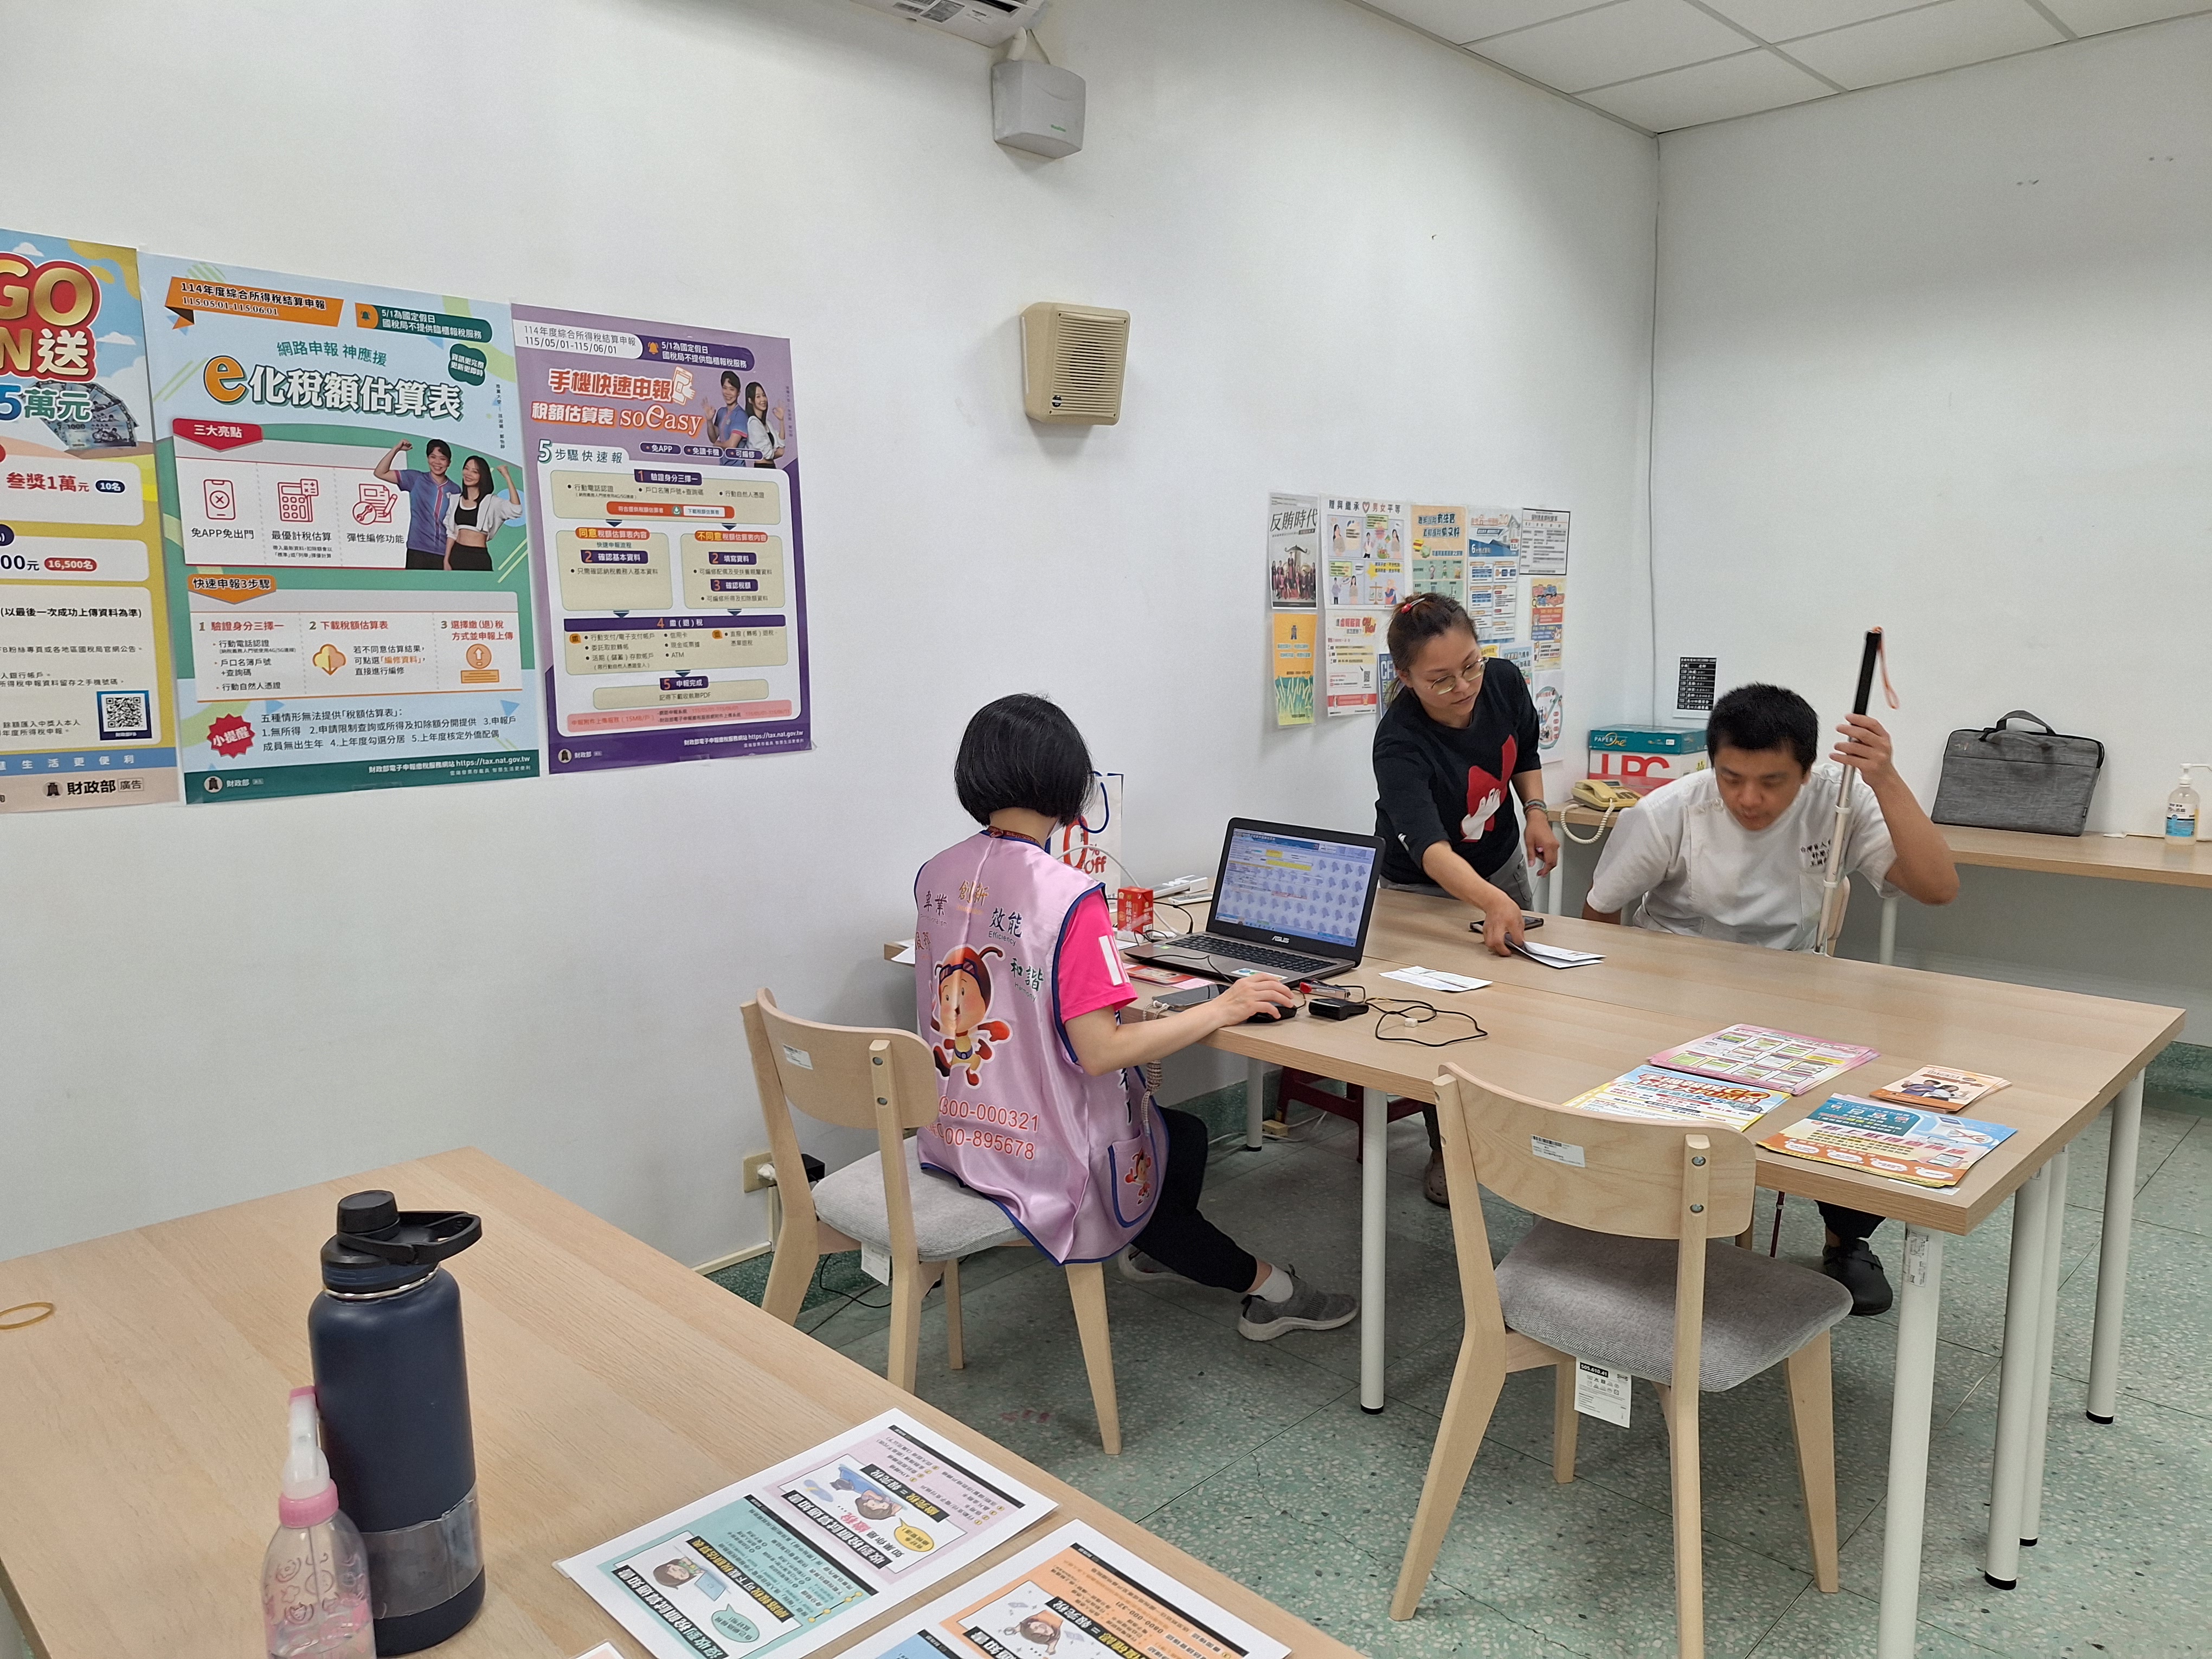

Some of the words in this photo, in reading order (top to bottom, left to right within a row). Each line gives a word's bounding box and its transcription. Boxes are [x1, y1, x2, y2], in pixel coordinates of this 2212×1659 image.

[181, 282, 326, 310] 114年度綜合所得稅結算申報
[183, 297, 279, 316] 115.05.01-115.06.01
[381, 309, 435, 324] 5/1為國定假日
[382, 319, 482, 339] 國稅局不提供臨櫃報稅服務
[524, 325, 636, 346] 114年度綜合所得稅結算申報
[525, 336, 617, 354] 115/05/01-115/06/01
[661, 342, 708, 354] 5/1為國定假日
[277, 340, 339, 357] 網路申報
[343, 344, 387, 367] 神應援
[662, 351, 747, 369] 國稅局不提供臨櫃報稅服務
[203, 355, 464, 422] e化稅額估算表
[550, 370, 671, 402] 手機快速申報
[0, 384, 92, 420] 5萬元
[531, 402, 615, 426] 稅額估算表
[194, 425, 243, 438] 三大亮點
[538, 439, 552, 463] 5
[555, 448, 623, 464] 步驟快速報
[651, 444, 673, 453] 免APP
[692, 447, 719, 456] 免讀卡機
[736, 450, 756, 459] 可編修
[7, 472, 90, 492] 叁獎1萬元
[99, 481, 121, 492] 10名
[638, 470, 644, 481] 1
[651, 473, 698, 483] 驗證身分三擇一
[574, 484, 614, 492] 行動電話認證
[191, 528, 254, 539] 免APP免出門
[272, 530, 332, 541] 最優計稅估算
[347, 533, 404, 544] 彈性編修功能
[579, 529, 647, 539] 同意稅額估算表內容
[584, 551, 593, 562] 2
[598, 554, 641, 562] 確認基本資料
[712, 553, 719, 563] 2
[48, 560, 93, 570] 16,500名
[193, 578, 271, 590] 快速申報3步驟
[714, 580, 721, 591] 3
[1, 607, 142, 618] (以最後一次成功上傳資料為準)
[200, 622, 205, 631] 1
[211, 621, 285, 631] 驗證身分三擇一
[309, 621, 317, 630] 2
[320, 620, 388, 631] 下載稅額估算表
[441, 621, 447, 629] 3
[451, 620, 504, 629] 選擇繳(退)稅
[657, 618, 665, 628] 4
[219, 640, 269, 648] 行動電話認證
[452, 632, 513, 641] 方式並申報上傳
[221, 658, 272, 666] 戶口名簿戶號
[355, 667, 405, 676] 直接進行編修
[222, 683, 281, 691] 行動自然人憑證
[664, 679, 671, 690] 5
[262, 726, 301, 737] 1.無所得
[309, 718, 477, 735] 2.申請限制查詢或所得及扣除額分開提供
[483, 716, 516, 725] 3.申報戶
[213, 726, 250, 748] 小提醒
[263, 740, 324, 752] 成員無出生年
[330, 735, 406, 748] 4.上年度勾選分居
[411, 730, 499, 743] 5.上年度核定外僑配偶
[748, 730, 803, 740] https://tax.nat.gov.tw
[456, 756, 530, 767] https://tax.nat.gov.tw
[67, 780, 116, 795] 財政部
[120, 780, 143, 790] 廣告
[227, 779, 250, 787] 財政部
[959, 880, 989, 906] 創新
[923, 890, 948, 916] 專業
[989, 907, 1023, 937] 效能
[988, 930, 1017, 946] Efficiency
[1010, 957, 1044, 992] 和諧
[1581, 1364, 1607, 1377] 505.610.41
[869, 1469, 904, 1491] 報完稅
[903, 1493, 940, 1516] 繳完稅
[785, 1493, 888, 1565] 收到稅額試算通知書
[865, 1530, 905, 1558] 如果你是
[690, 1538, 790, 1619] 網路報稅可下載稅額估算表
[616, 1567, 723, 1659] 沒收到稅額試算通知書
[1049, 1600, 1094, 1628] 報完稅
[1113, 1601, 1165, 1633] 0800-000-321
